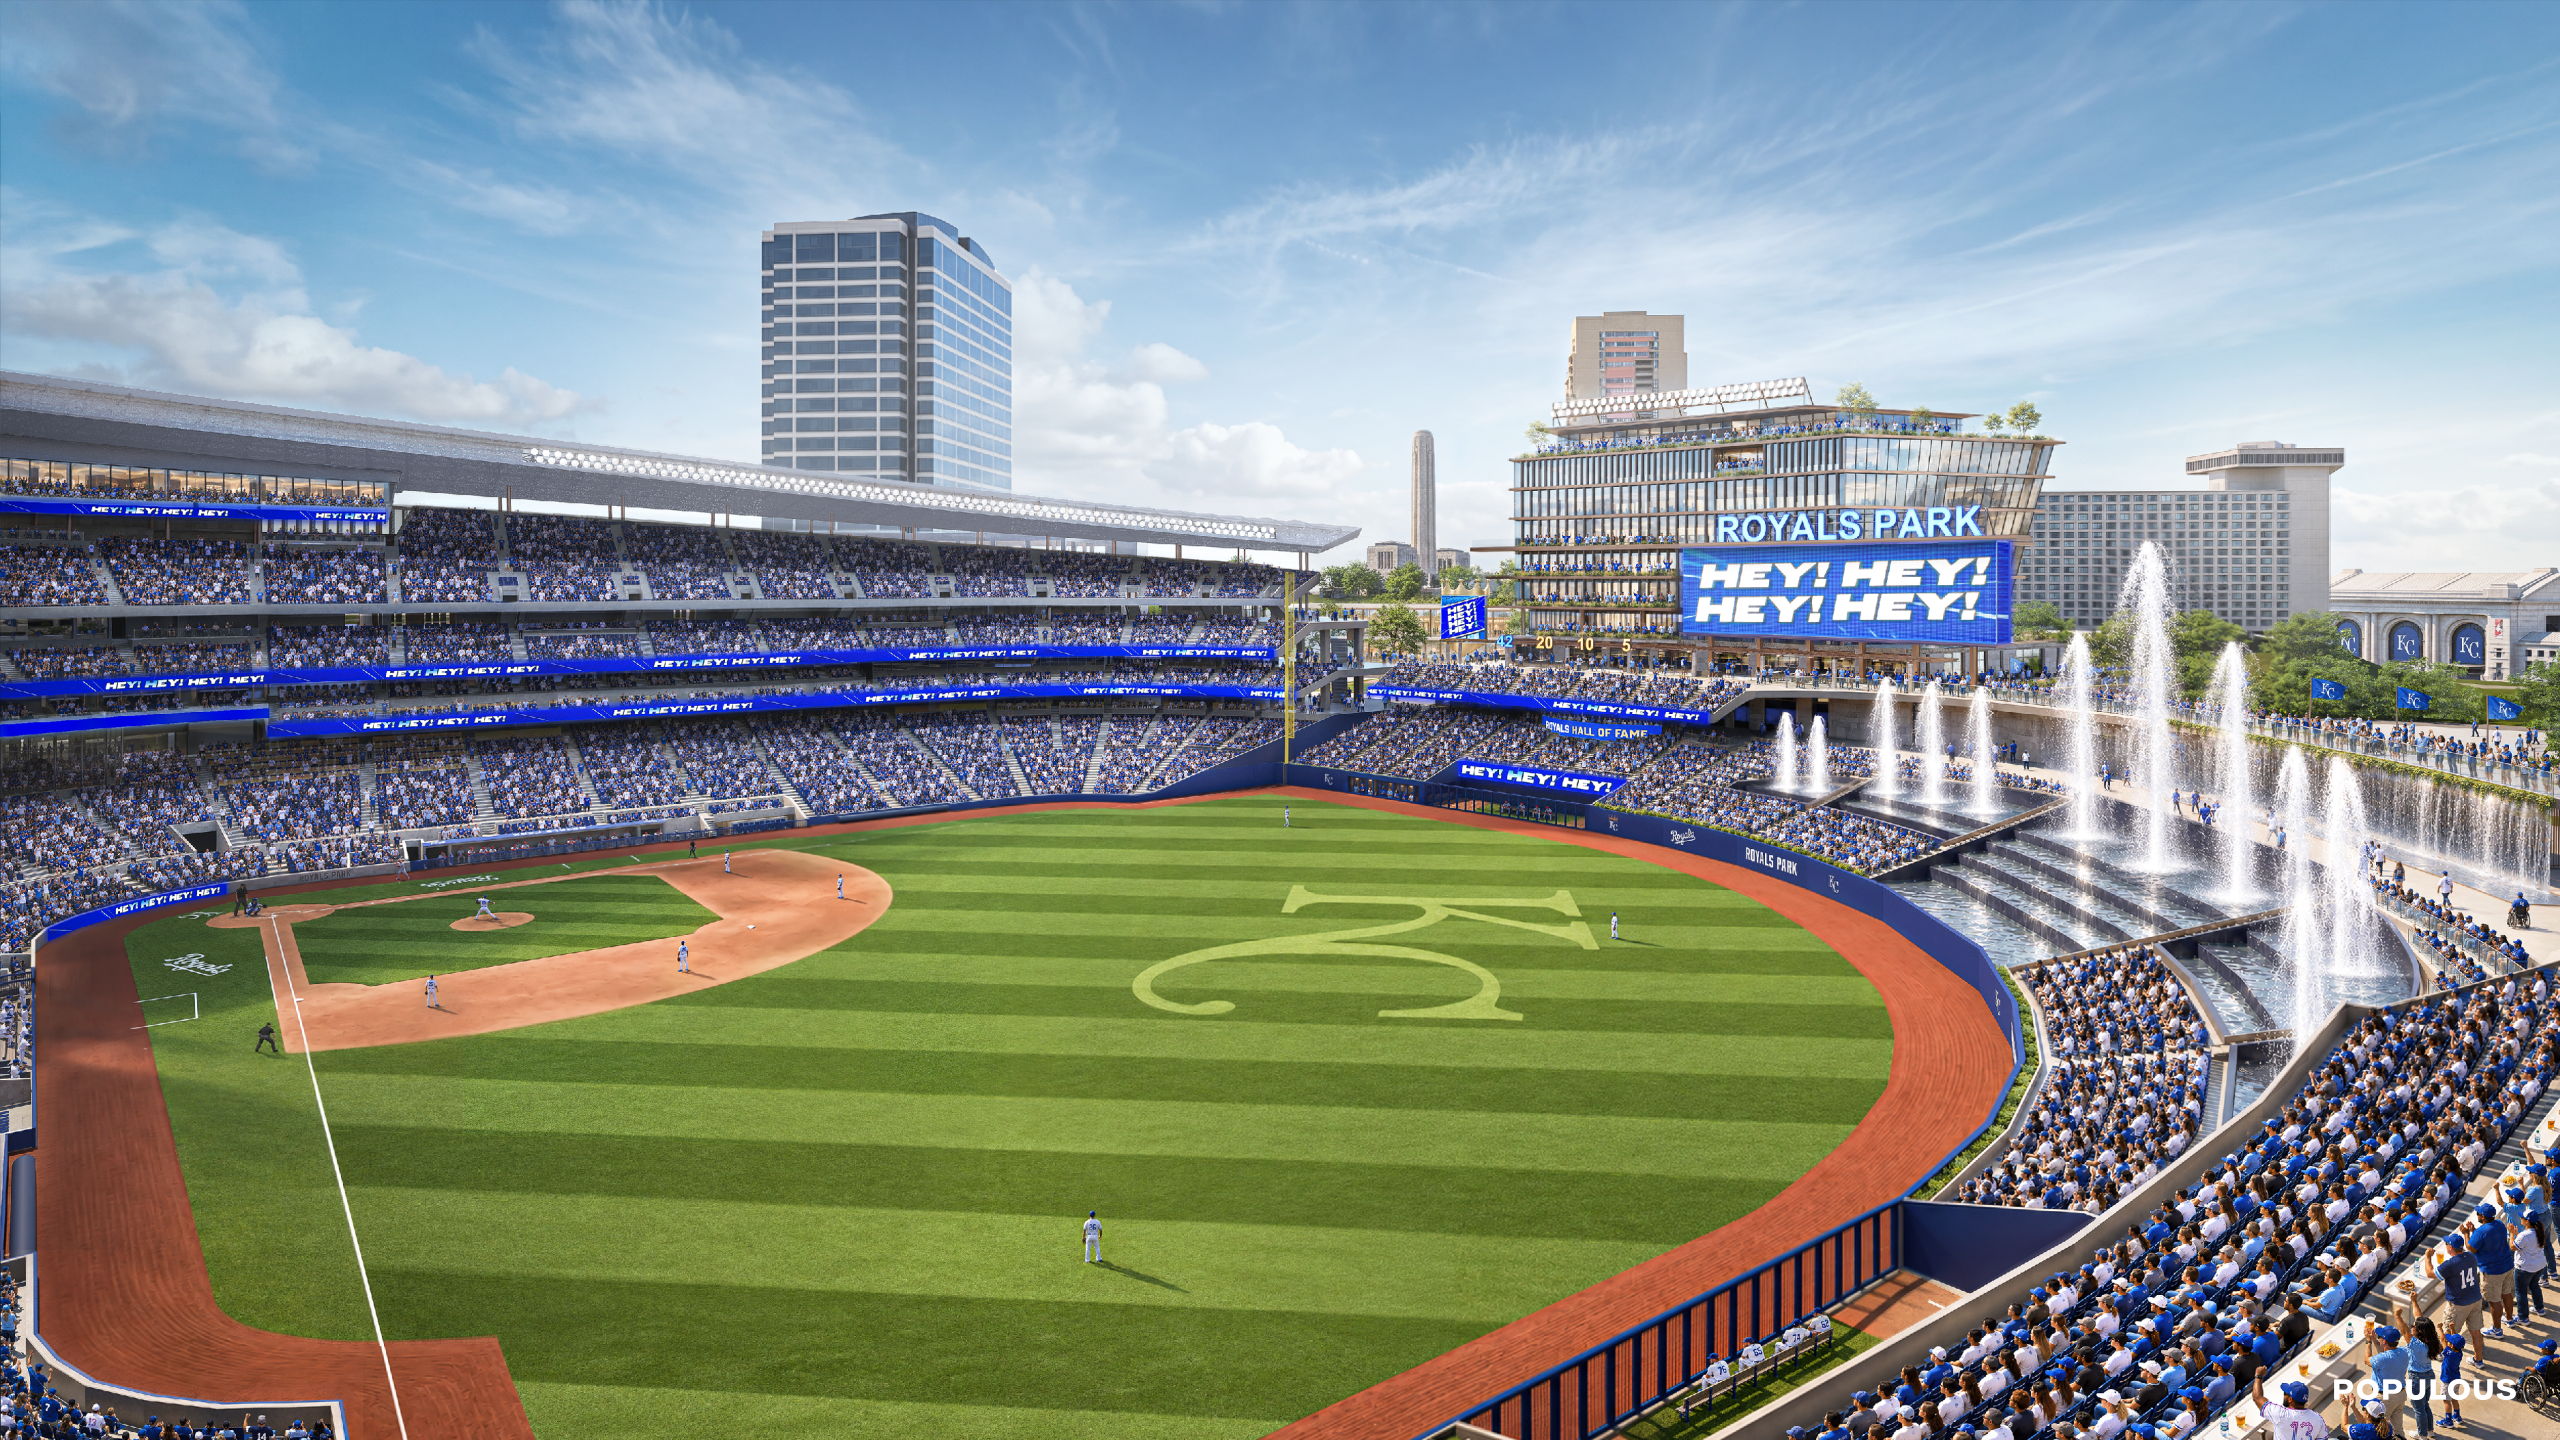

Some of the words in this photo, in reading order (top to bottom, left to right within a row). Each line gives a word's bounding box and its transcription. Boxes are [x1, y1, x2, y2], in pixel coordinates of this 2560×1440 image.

[1717, 511, 1862, 542] ROYALS
[1874, 505, 1985, 539] PARK
[1699, 562, 1830, 589] HEY!
[1841, 557, 1991, 587] HEY!
[1448, 601, 1476, 614] HEY!
[1448, 608, 1476, 621] HEY!
[1695, 596, 1824, 623] HEY!
[1831, 592, 1980, 621] HEY!
[1449, 615, 1477, 628] HEY!
[1449, 621, 1478, 635] HEY!
[1496, 635, 1513, 648] 42
[1536, 636, 1553, 649] 20
[1577, 637, 1594, 651] 10
[1621, 638, 1631, 652] 5
[2397, 634, 2415, 656] KC
[2460, 636, 2481, 659] KC
[692, 658, 729, 666] HEY!
[732, 657, 764, 665] HEY!
[425, 668, 463, 676] HEY!
[106, 681, 141, 689] HEY!
[145, 679, 183, 687] HEY!
[188, 677, 223, 685] HEY!
[229, 675, 264, 683] HEY!
[2321, 682, 2335, 699] KC
[2407, 692, 2421, 709] KC
[613, 708, 645, 716] HEY!
[649, 706, 683, 714] HEY!
[1552, 700, 1584, 710] HEY!
[1587, 703, 1622, 713] HEY!
[1626, 707, 1659, 716] HEY!
[1665, 710, 1701, 720] HEY!
[398, 719, 433, 727] HEY!
[1546, 720, 1570, 734] ROYALS
[1572, 725, 1595, 736] HALL
[1598, 728, 1612, 737] OF
[1615, 729, 1648, 739] FAME
[1462, 764, 1503, 778] HEY!
[1507, 770, 1556, 786] HEY!
[1562, 777, 1613, 792] HEY!
[1670, 828, 1696, 845] Royals
[1745, 847, 1773, 868] ROYALS
[1776, 857, 1797, 876] PARK
[299, 873, 329, 882] ROYALS
[331, 870, 352, 879] PARK
[116, 903, 138, 914] HEY!
[141, 895, 166, 908] HEY!
[169, 891, 192, 901] HEY!
[197, 887, 220, 896] HEY!
[2460, 1267, 2475, 1290] 14
[1821, 1319, 1829, 1329] 62
[1792, 1333, 1800, 1343] 74
[1717, 1366, 1727, 1376] 76
[45, 1402, 50, 1412] 7
